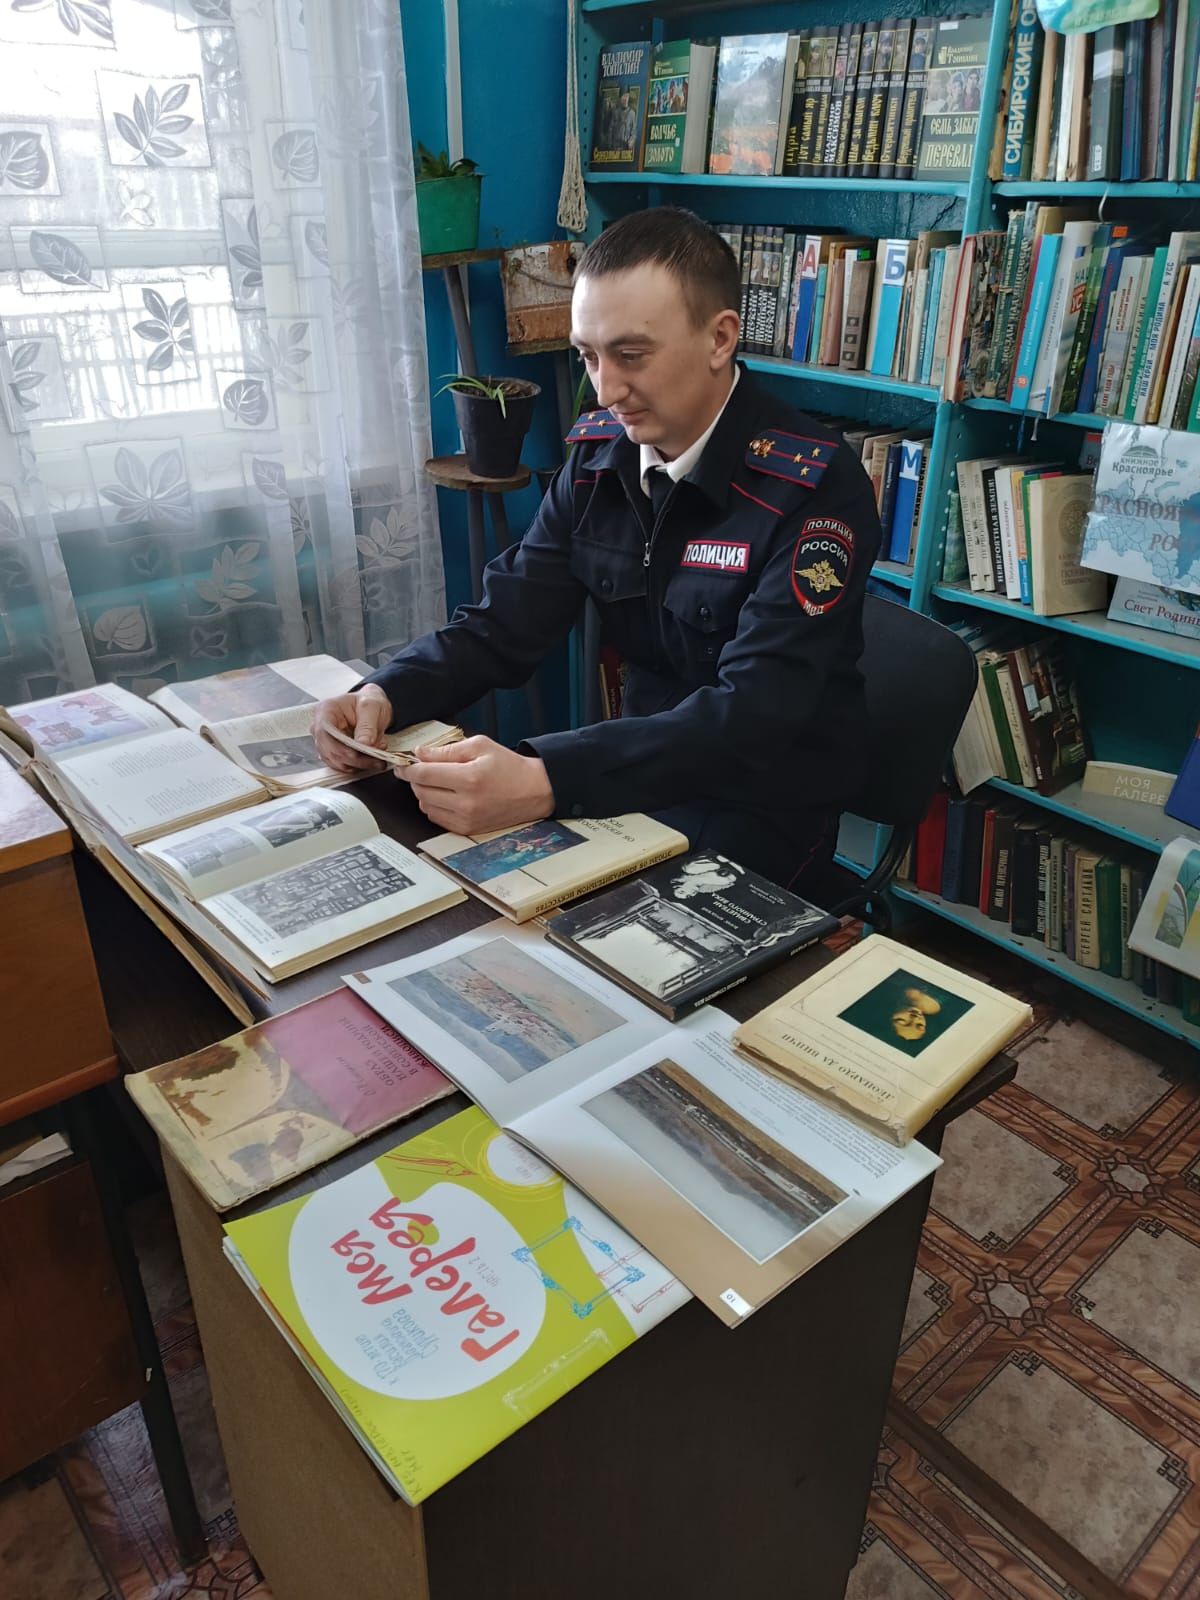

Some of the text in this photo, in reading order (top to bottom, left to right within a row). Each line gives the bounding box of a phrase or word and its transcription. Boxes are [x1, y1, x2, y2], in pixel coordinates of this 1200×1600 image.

[601, 49, 644, 65] ВЛАДИМИР
[603, 63, 640, 77] ТОПИЛИН
[1004, 32, 1035, 164] СИБИРСКИЕ
[651, 123, 677, 140] ВОЛЧЬЕ
[828, 101, 842, 162] МАКСИМОВ
[931, 118, 952, 135] СЕМЬ
[648, 146, 675, 163] ЗОЛОТО
[925, 144, 975, 168] ПЕРЕВАЛ
[802, 243, 816, 274] А
[884, 250, 906, 280] Б
[1165, 261, 1174, 276] УСС
[1133, 295, 1147, 338] РОДИНА
[1153, 300, 1166, 332] РОДИНА
[1149, 332, 1159, 351] МОЯ
[1143, 358, 1153, 378] КРАЙ
[1139, 379, 1150, 397] НАШ
[902, 446, 921, 474] М
[1112, 462, 1174, 477] Красноярье
[1121, 458, 1160, 467] книжное
[807, 519, 853, 542] ПОЛИЦИЯ
[683, 544, 748, 570] ПОЛИЦИЯ
[801, 541, 848, 567] РОССИЯ
[991, 514, 1003, 582] НЕВЕРОЯТНАЯ
[803, 600, 825, 616] МВД
[1124, 599, 1153, 615] Свет
[1113, 786, 1166, 805] ГАЛЕРЕ
[1116, 776, 1151, 790] МОЯ
[711, 892, 729, 904] ВЕКА
[1078, 868, 1093, 954] СЕРГЕЙ САРТАКОВ
[712, 899, 751, 925] СВИДЕТЕЛИ
[727, 901, 767, 927] СТРАННОГО
[338, 1017, 376, 1050] РОДИНЫ
[781, 1032, 821, 1060] ВИНЧИ
[362, 1024, 419, 1076] В СОВЕТСКОЙ
[380, 1024, 431, 1070] ЖИВОПИСИ
[365, 1058, 395, 1086] ОБРАЗ
[372, 1049, 408, 1081] НАШЕЙ
[821, 1056, 839, 1069] ДА
[838, 1062, 896, 1100] ЛЕОНАРДО
[330, 1229, 413, 1305] Моя
[368, 1196, 520, 1362] Галерея
[391, 1308, 440, 1360] Сурикова
